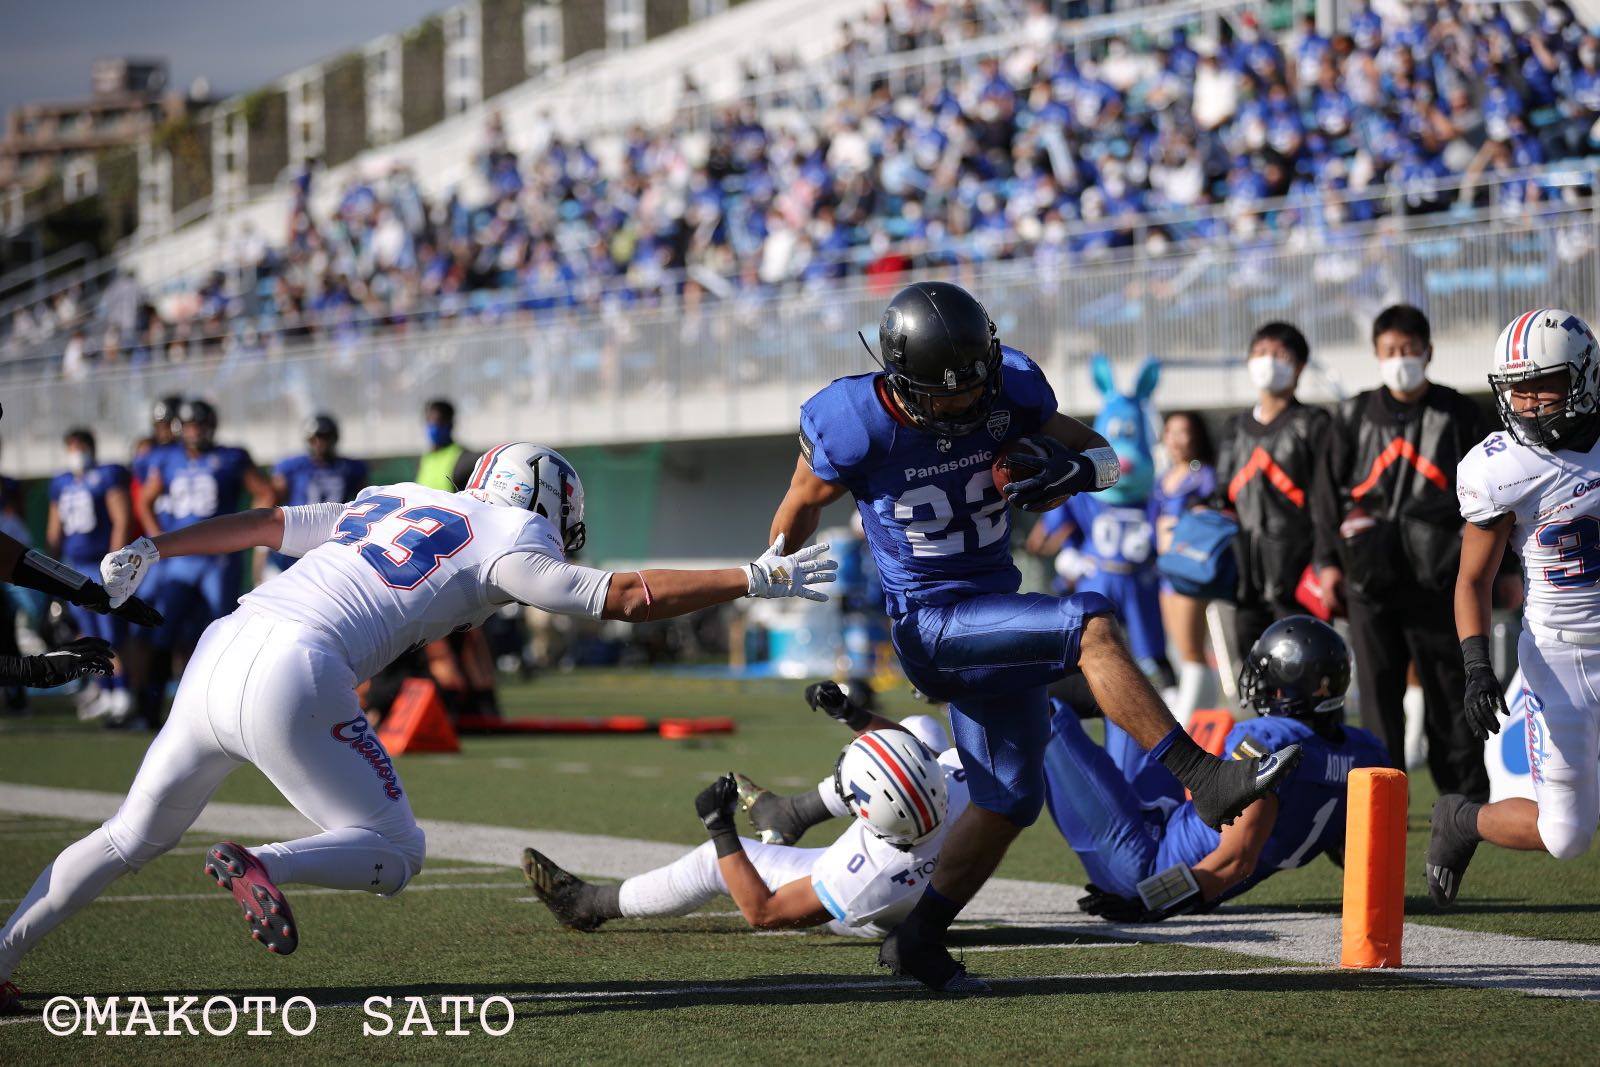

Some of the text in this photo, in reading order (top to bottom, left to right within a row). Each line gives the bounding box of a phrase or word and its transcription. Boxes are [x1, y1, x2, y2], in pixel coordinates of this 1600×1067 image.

[904, 449, 993, 482] Panasonic
[1483, 435, 1507, 458] 32
[894, 468, 1008, 557] 22
[333, 493, 475, 592] 33
[1279, 797, 1338, 869] 1
[846, 853, 866, 874] 0
